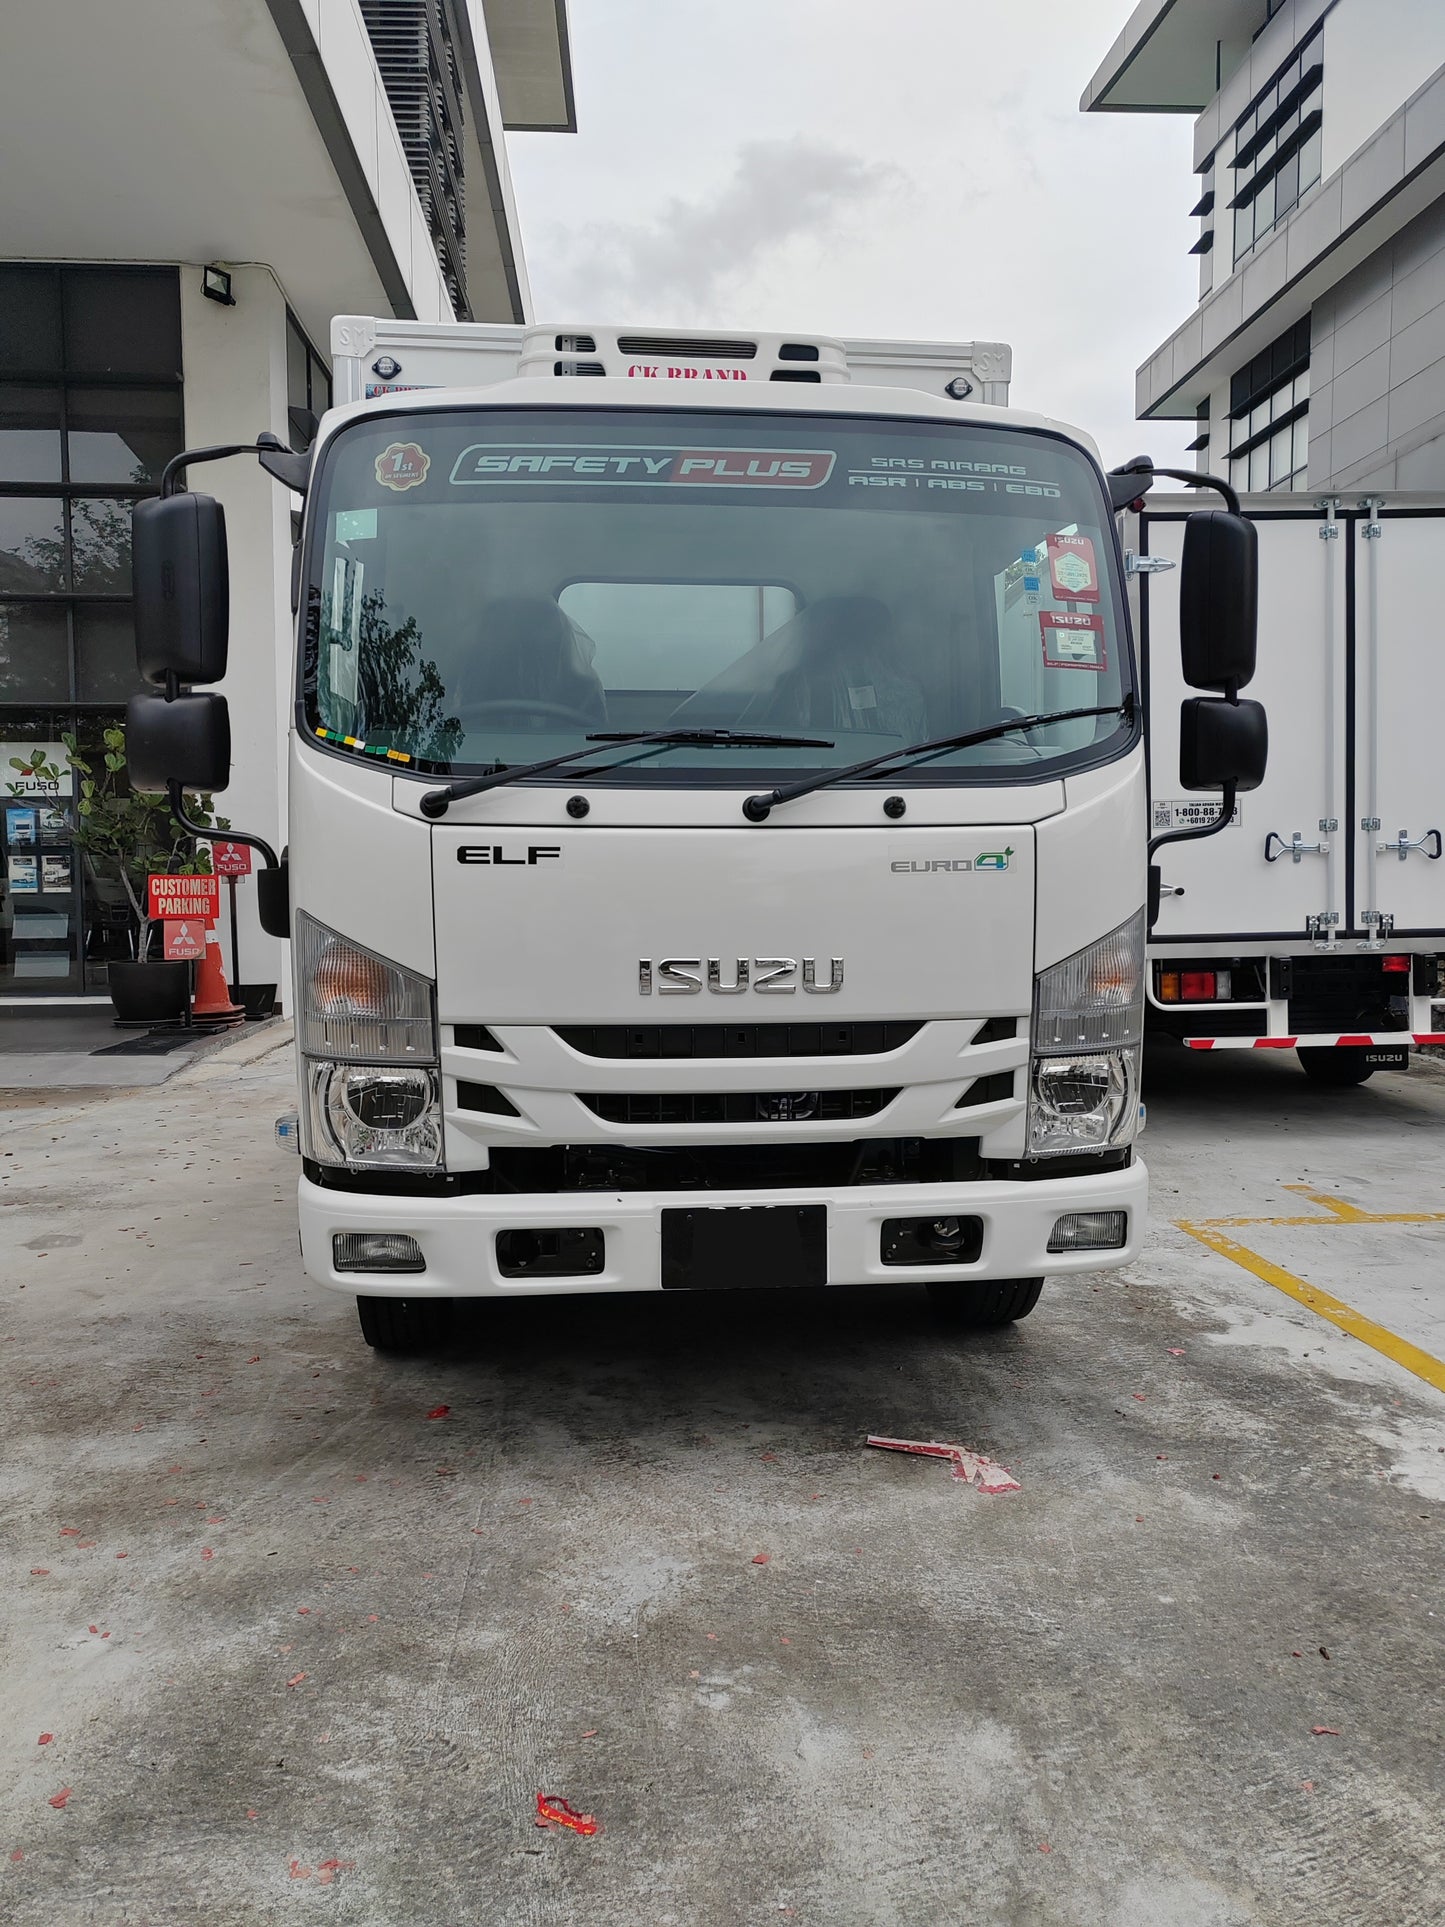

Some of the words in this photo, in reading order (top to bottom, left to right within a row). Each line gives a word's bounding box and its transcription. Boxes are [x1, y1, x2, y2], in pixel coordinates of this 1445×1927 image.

[474, 455, 673, 474] SAFETY
[679, 458, 812, 478] PLUS
[871, 457, 925, 469] SRS
[930, 460, 1027, 475] AIRBAG
[848, 476, 907, 487] ASR
[927, 479, 985, 491] ABS
[1005, 484, 1061, 498] EBD
[1054, 536, 1084, 545] ISUZU
[1051, 615, 1091, 625] ISUZU
[15, 781, 60, 790] FUSO
[457, 846, 561, 864] ELF
[217, 863, 247, 871] FUSO
[151, 879, 216, 896] CUSTOMER
[158, 897, 210, 915] PARKING
[168, 948, 200, 956] FUSO
[638, 956, 844, 995] ISUZU
[1365, 1054, 1403, 1062] ISUZU
